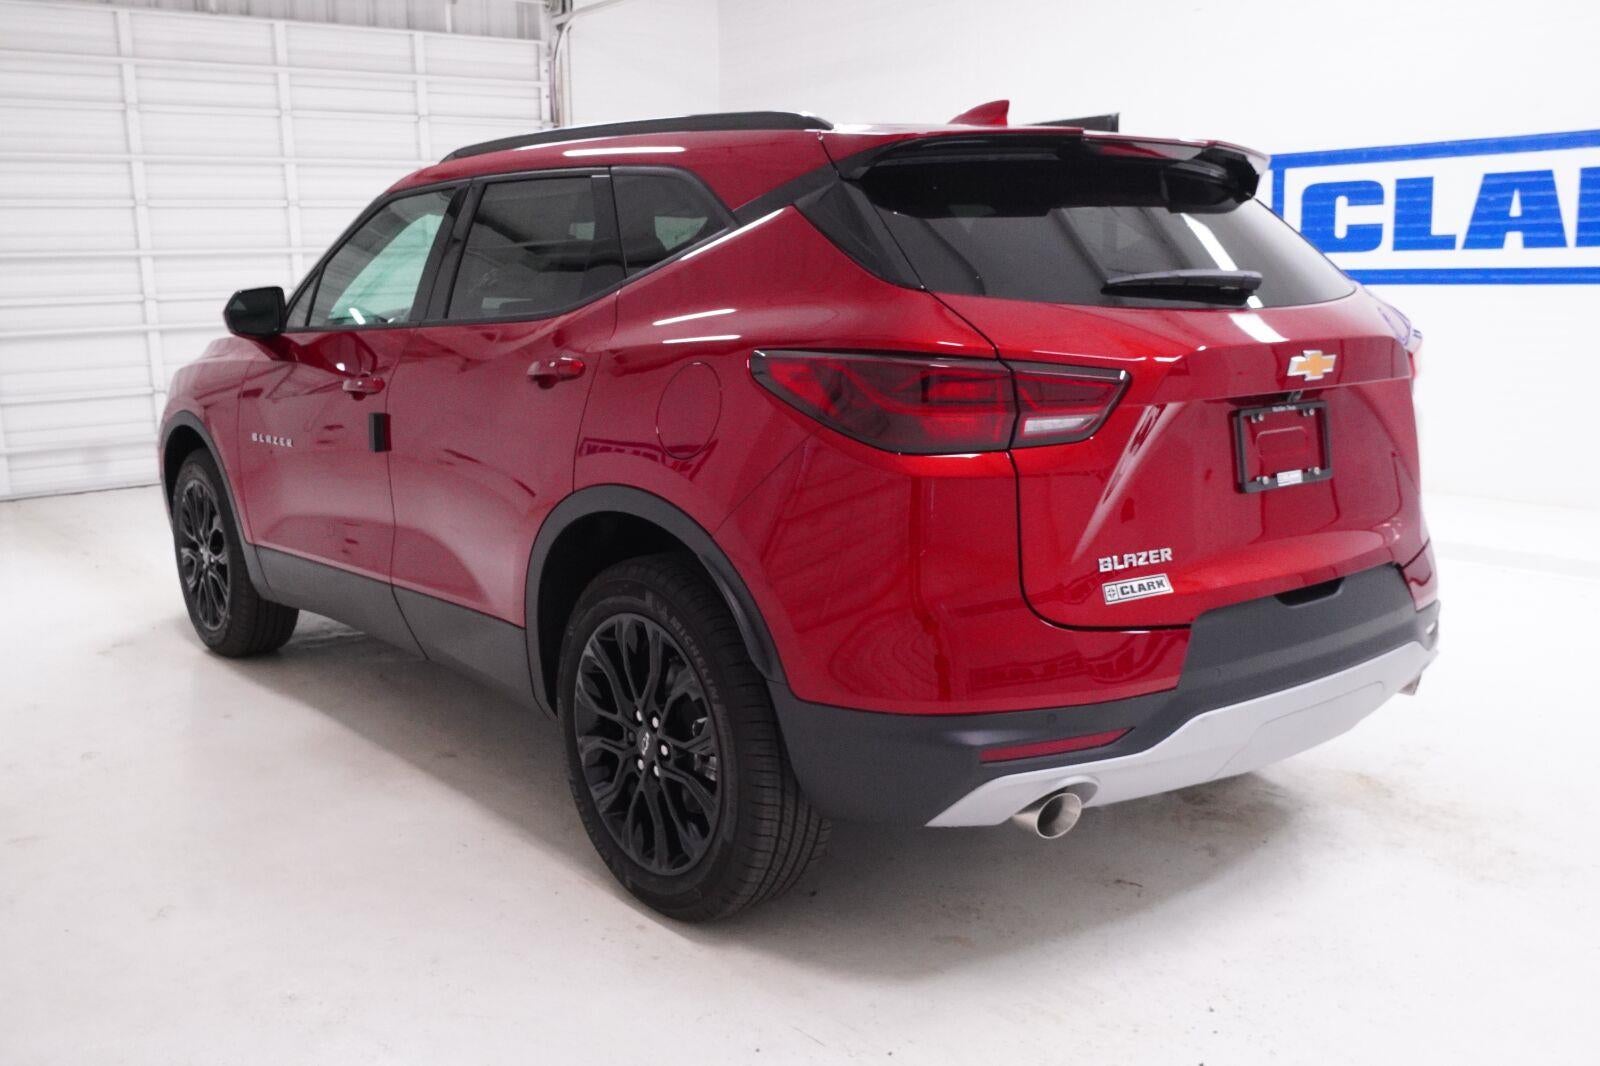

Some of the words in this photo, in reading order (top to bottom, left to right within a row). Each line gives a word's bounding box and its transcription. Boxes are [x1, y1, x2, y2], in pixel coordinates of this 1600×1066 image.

[1300, 167, 1600, 252] CLA
[251, 432, 293, 448] BLAZER
[1098, 547, 1173, 573] BLAZER
[1119, 579, 1166, 596] CLARK
